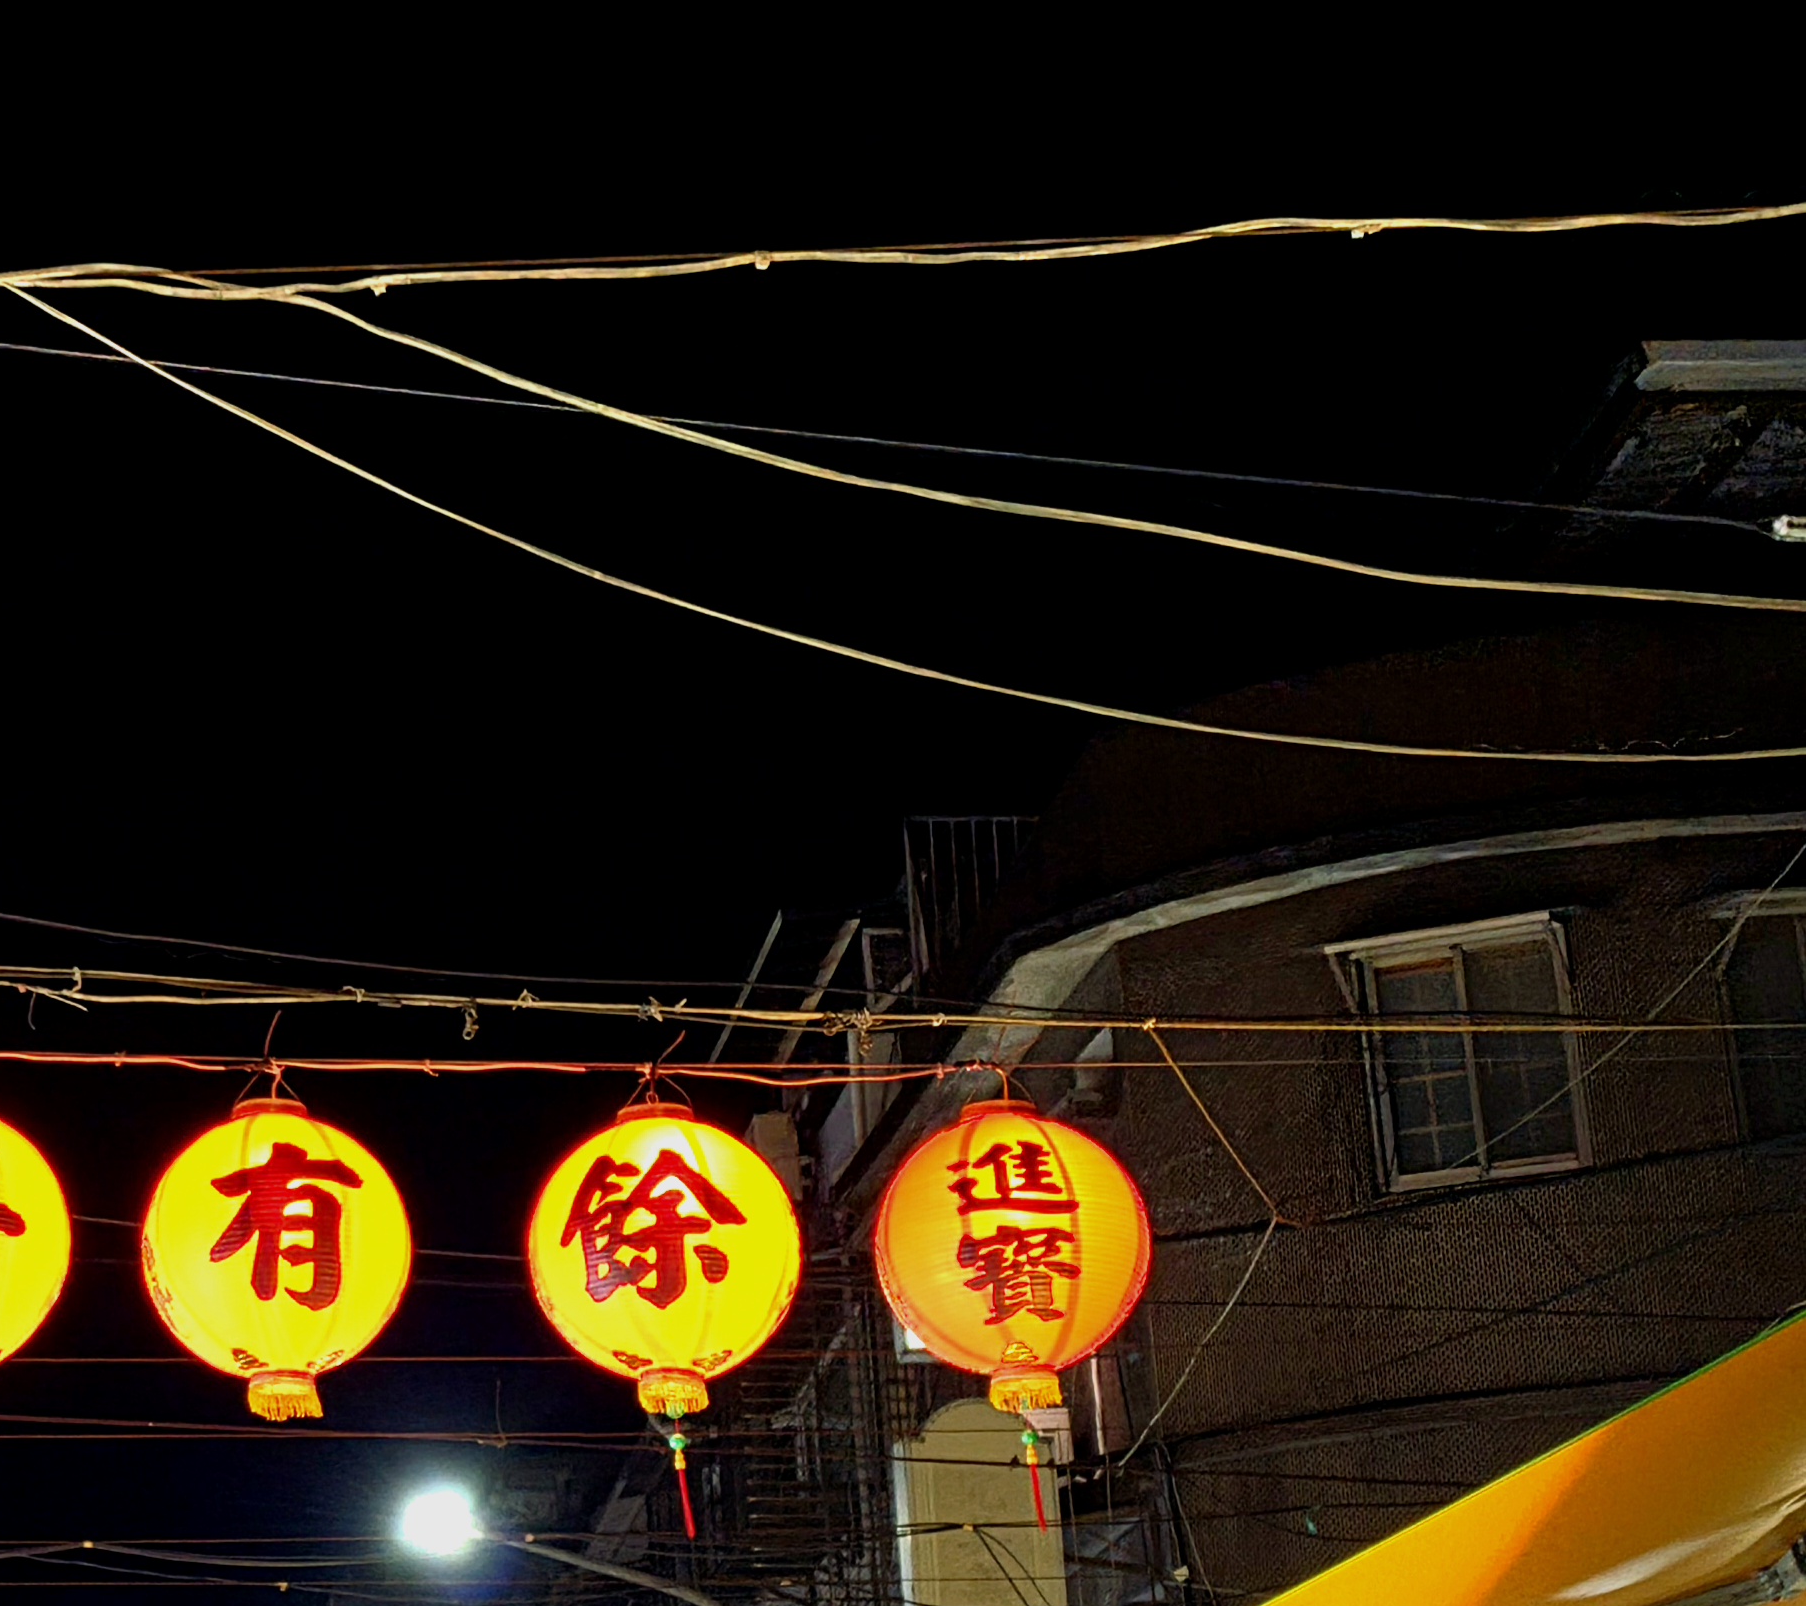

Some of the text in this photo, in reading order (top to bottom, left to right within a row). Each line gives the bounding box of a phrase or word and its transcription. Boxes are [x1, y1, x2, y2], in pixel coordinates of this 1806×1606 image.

[209, 1141, 364, 1312] 有
[560, 1147, 747, 1311] 餘
[946, 1141, 1082, 1326] 進寶
